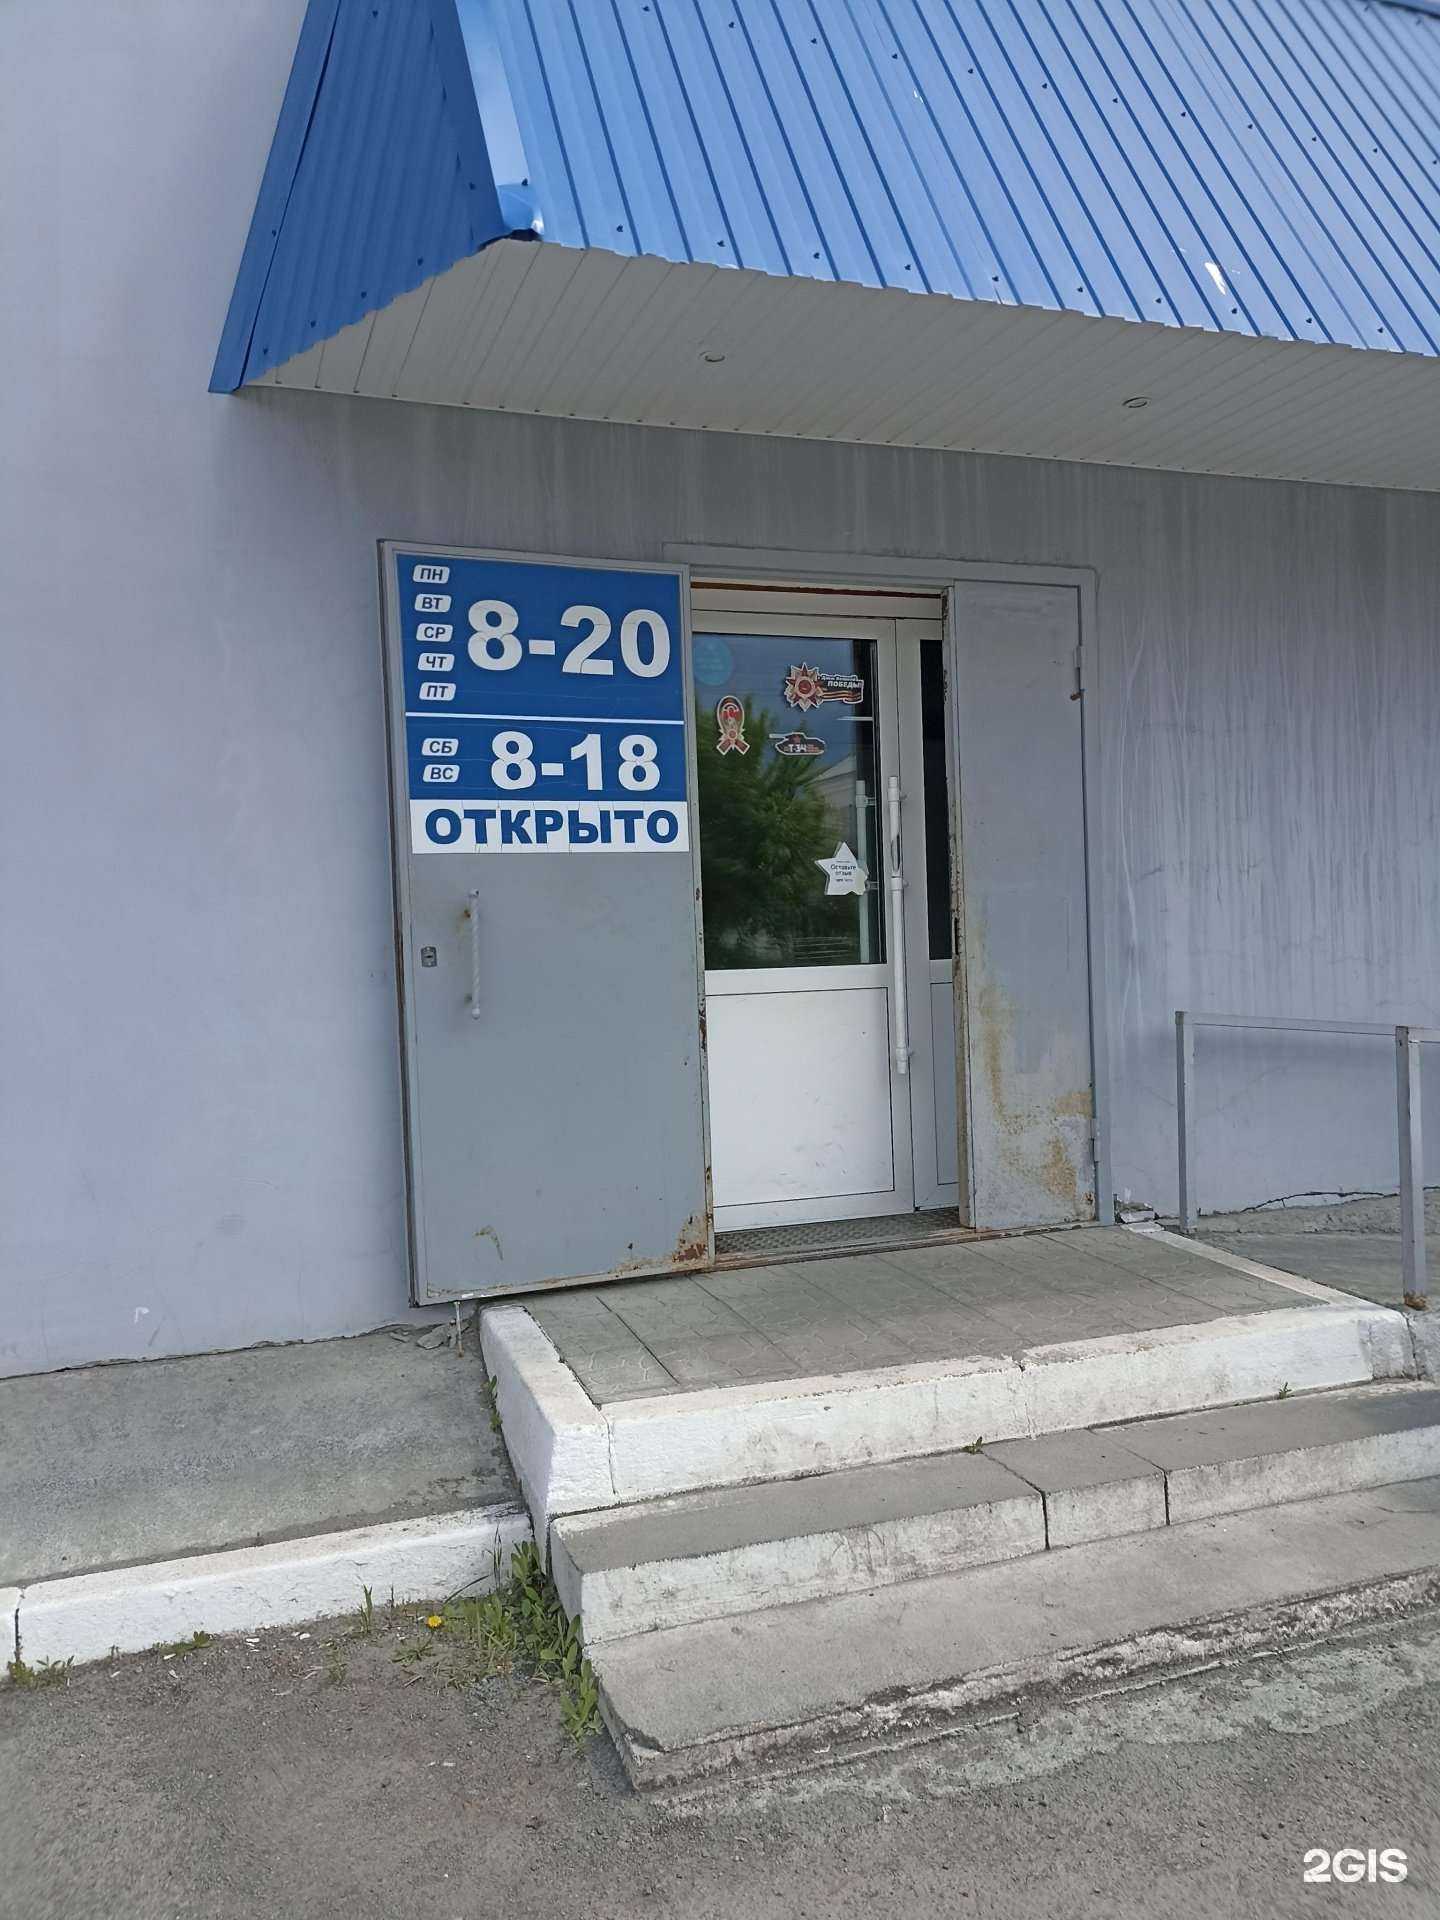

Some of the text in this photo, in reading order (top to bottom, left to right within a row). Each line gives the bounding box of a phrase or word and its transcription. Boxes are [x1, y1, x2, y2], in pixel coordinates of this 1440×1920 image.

[419, 567, 444, 581] ПН
[421, 597, 444, 610] ВТ
[423, 626, 446, 639] СР
[467, 599, 671, 678] 8-20
[425, 656, 447, 669] ЧТ
[426, 685, 449, 698] ПТ
[429, 741, 453, 754] СБ
[490, 730, 661, 791] 8-18
[430, 767, 454, 781] ВС
[425, 808, 679, 845] ОТКРЫТО
